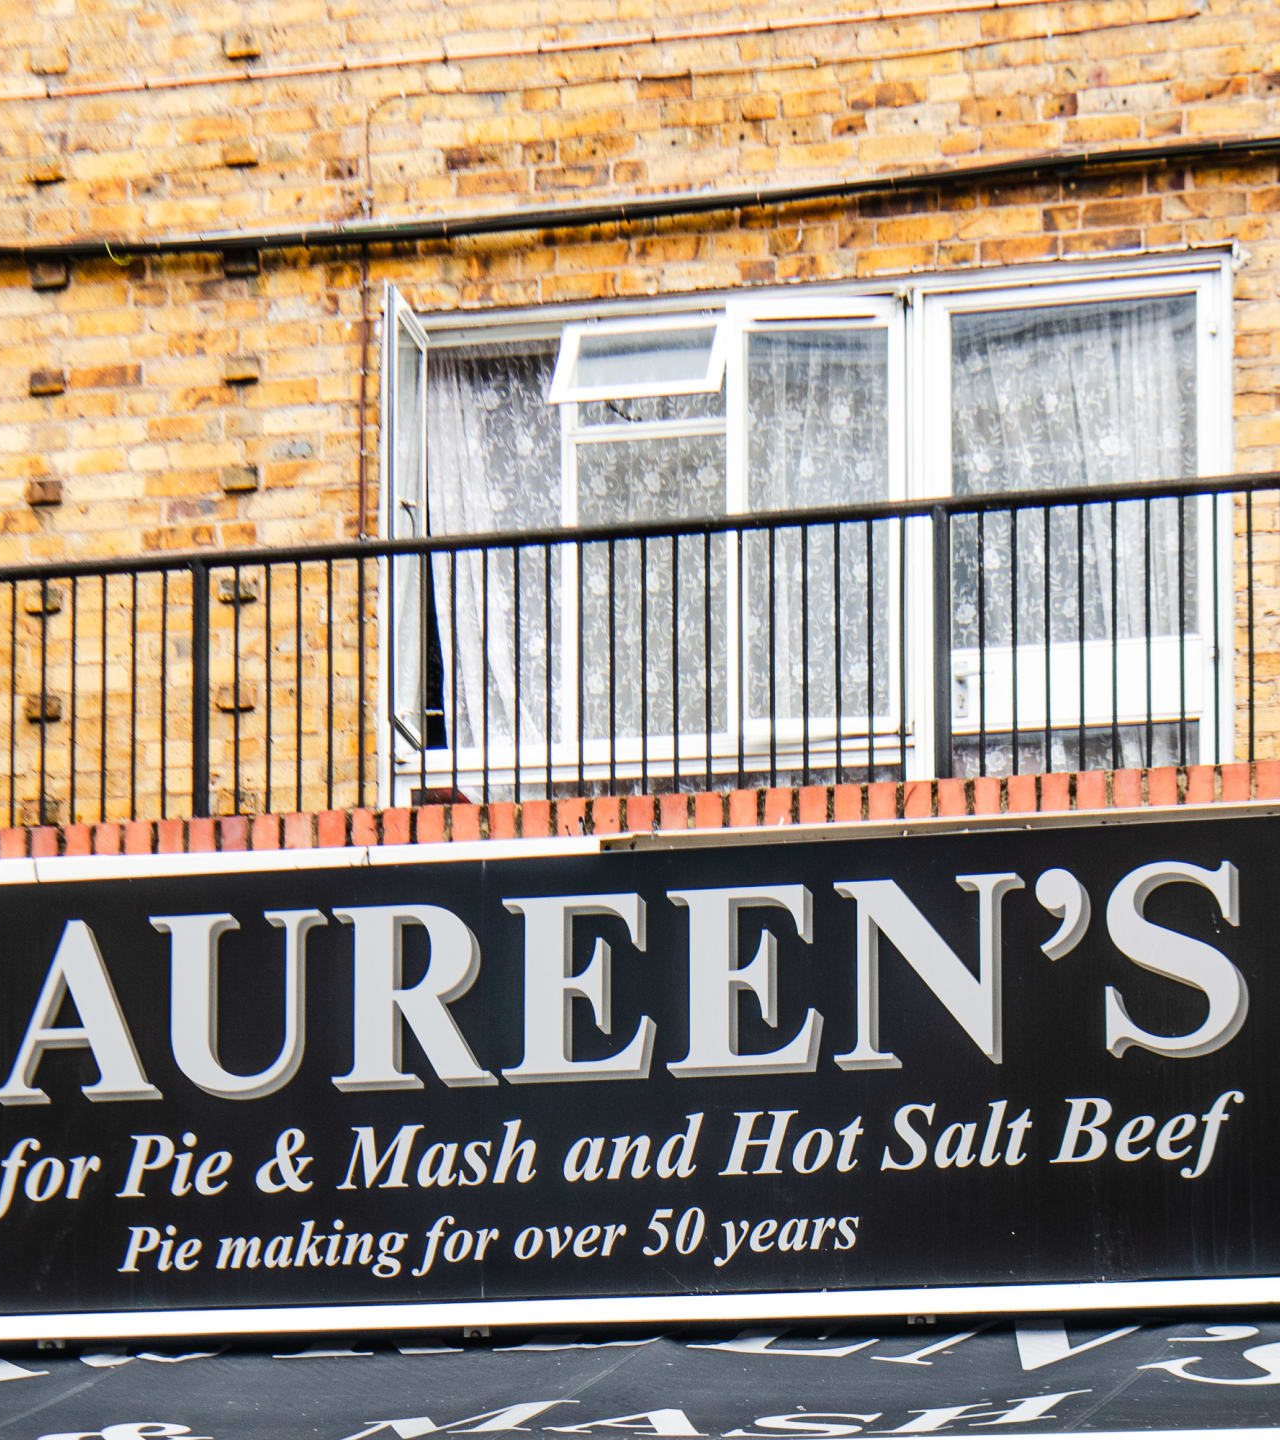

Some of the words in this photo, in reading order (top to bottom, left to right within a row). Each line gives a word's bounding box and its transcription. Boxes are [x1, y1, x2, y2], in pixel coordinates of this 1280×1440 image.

[117, 1131, 232, 1198] Pie
[255, 1127, 314, 1194] &
[337, 1119, 537, 1190] Mash
[564, 1112, 704, 1182] and
[719, 1110, 864, 1176] Hot
[880, 1102, 1034, 1172] Salt
[1050, 1090, 1245, 1179] Beef
[118, 1220, 201, 1273] Pie
[217, 1219, 414, 1279] making
[412, 1215, 498, 1277] for
[514, 1222, 626, 1262] over
[642, 1208, 706, 1257] 50
[714, 1212, 860, 1267] years
